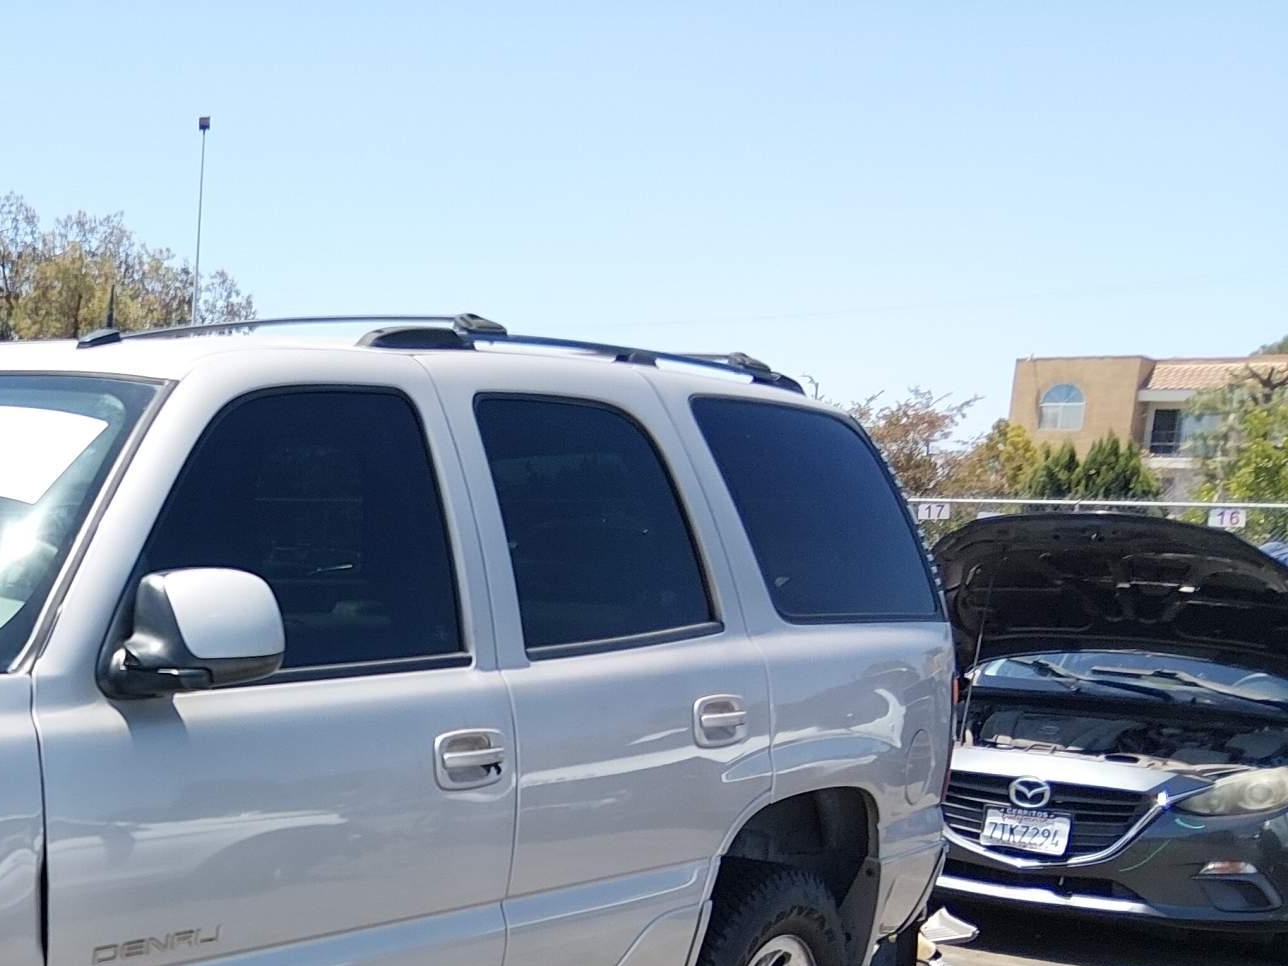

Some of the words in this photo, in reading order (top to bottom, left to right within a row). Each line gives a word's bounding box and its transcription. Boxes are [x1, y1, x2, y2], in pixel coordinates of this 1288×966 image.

[924, 504, 945, 519] 17
[1217, 510, 1241, 526] 16
[91, 923, 223, 966] DENALI
